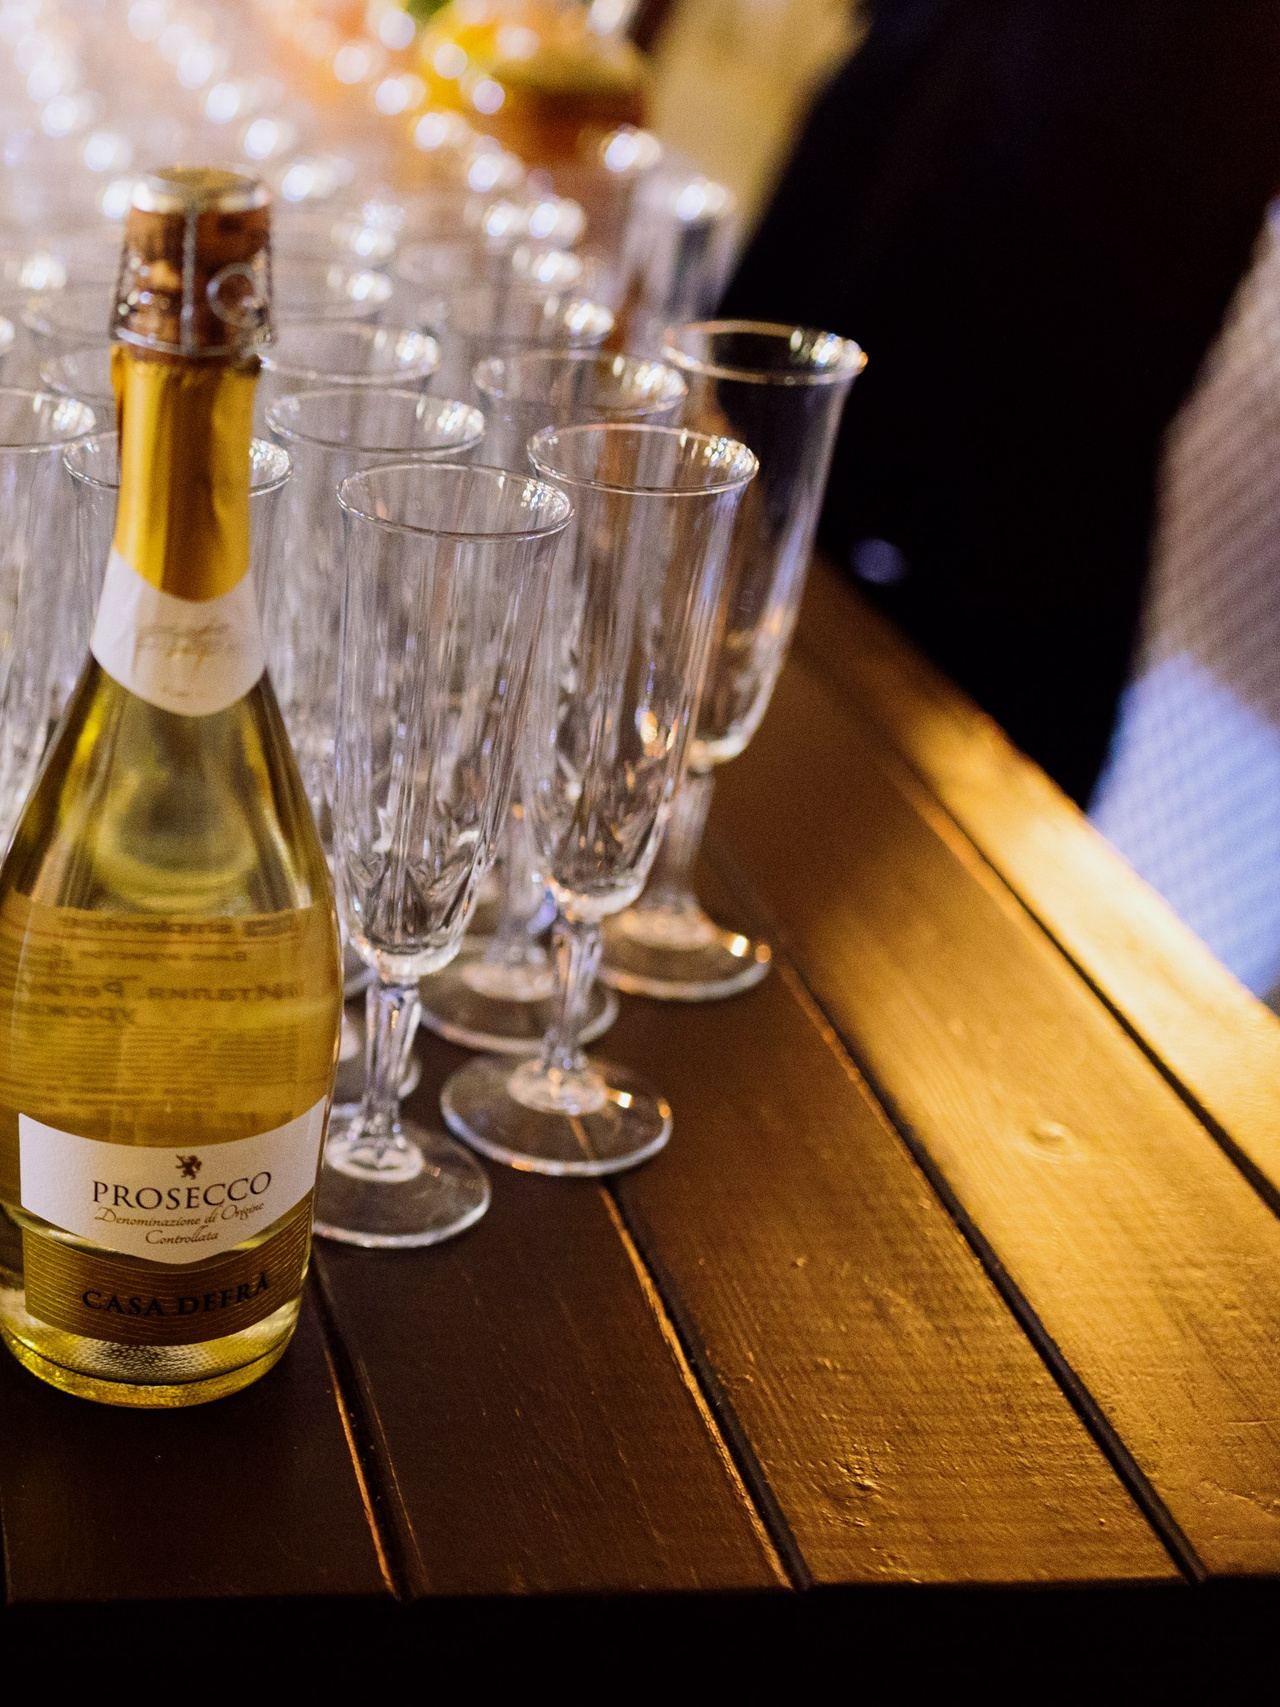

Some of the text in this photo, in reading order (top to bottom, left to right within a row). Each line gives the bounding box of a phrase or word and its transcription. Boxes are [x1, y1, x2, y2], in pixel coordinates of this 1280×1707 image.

[92, 1171, 272, 1210] PROSECCO
[93, 1200, 266, 1227] Denominazione di Origine
[144, 1224, 220, 1246] Controllata
[81, 1289, 167, 1317] CASA
